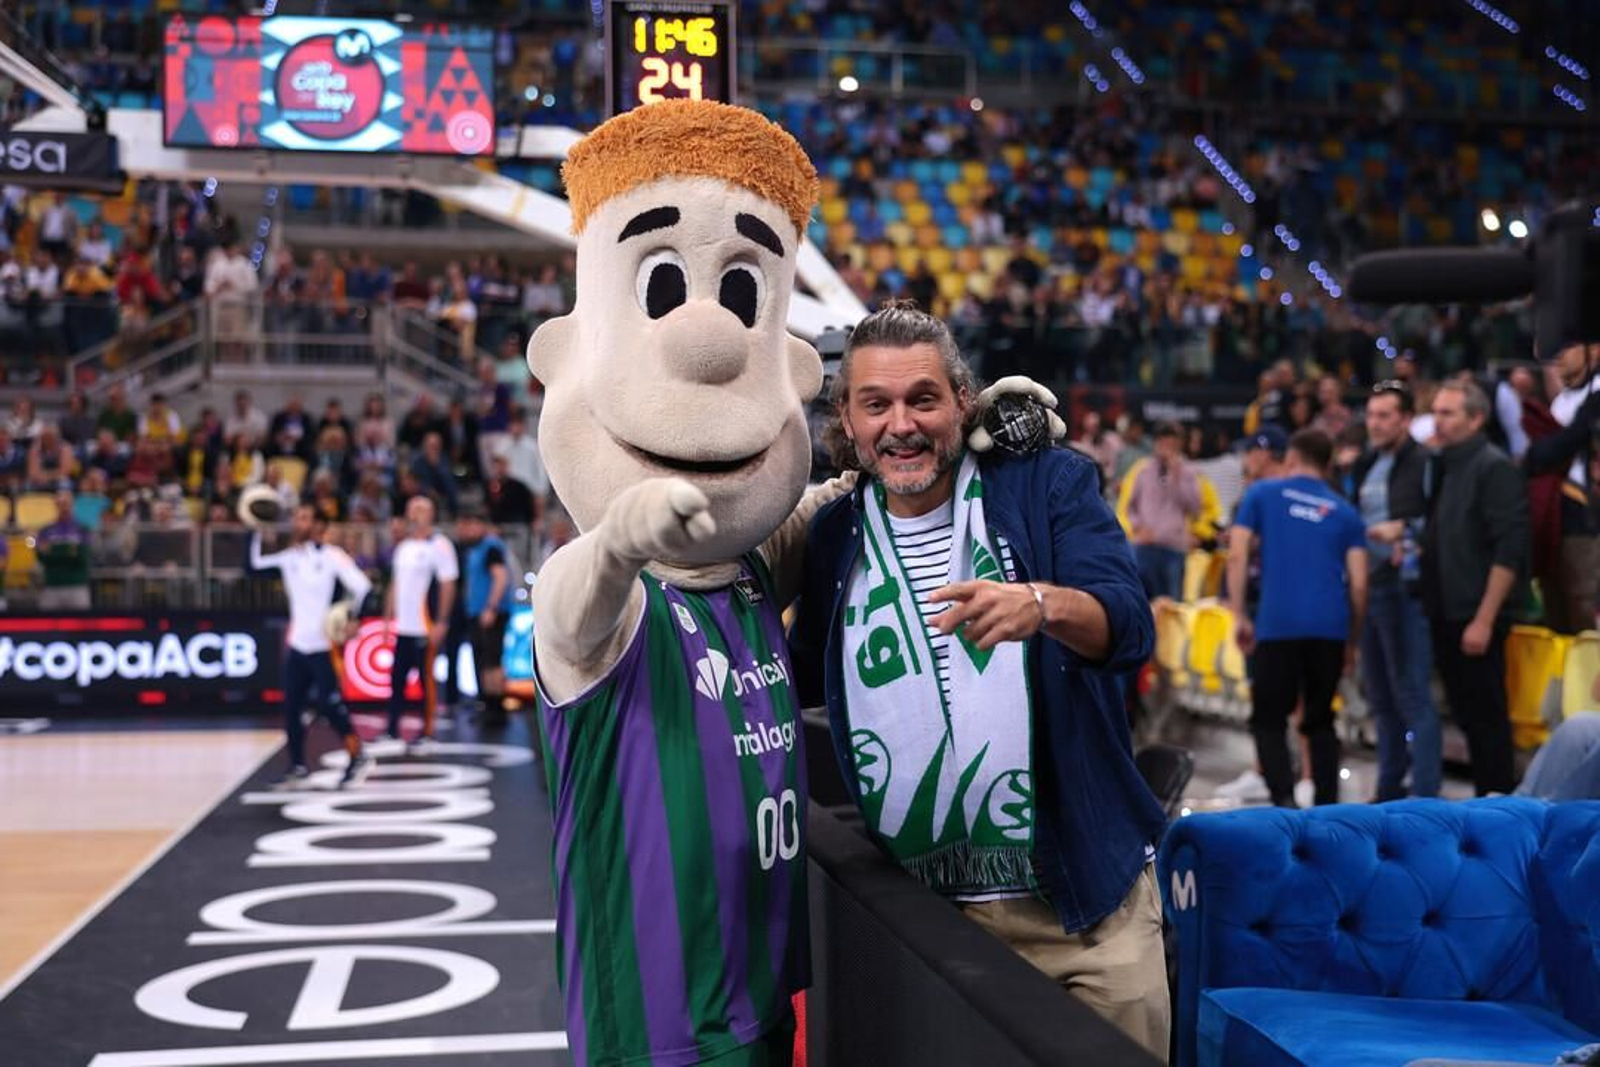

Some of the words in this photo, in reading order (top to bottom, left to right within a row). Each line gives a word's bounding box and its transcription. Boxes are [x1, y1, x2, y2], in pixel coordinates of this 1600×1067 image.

[635, 17, 717, 56] 11:46
[639, 57, 702, 105] 24
[757, 789, 799, 870] 00
